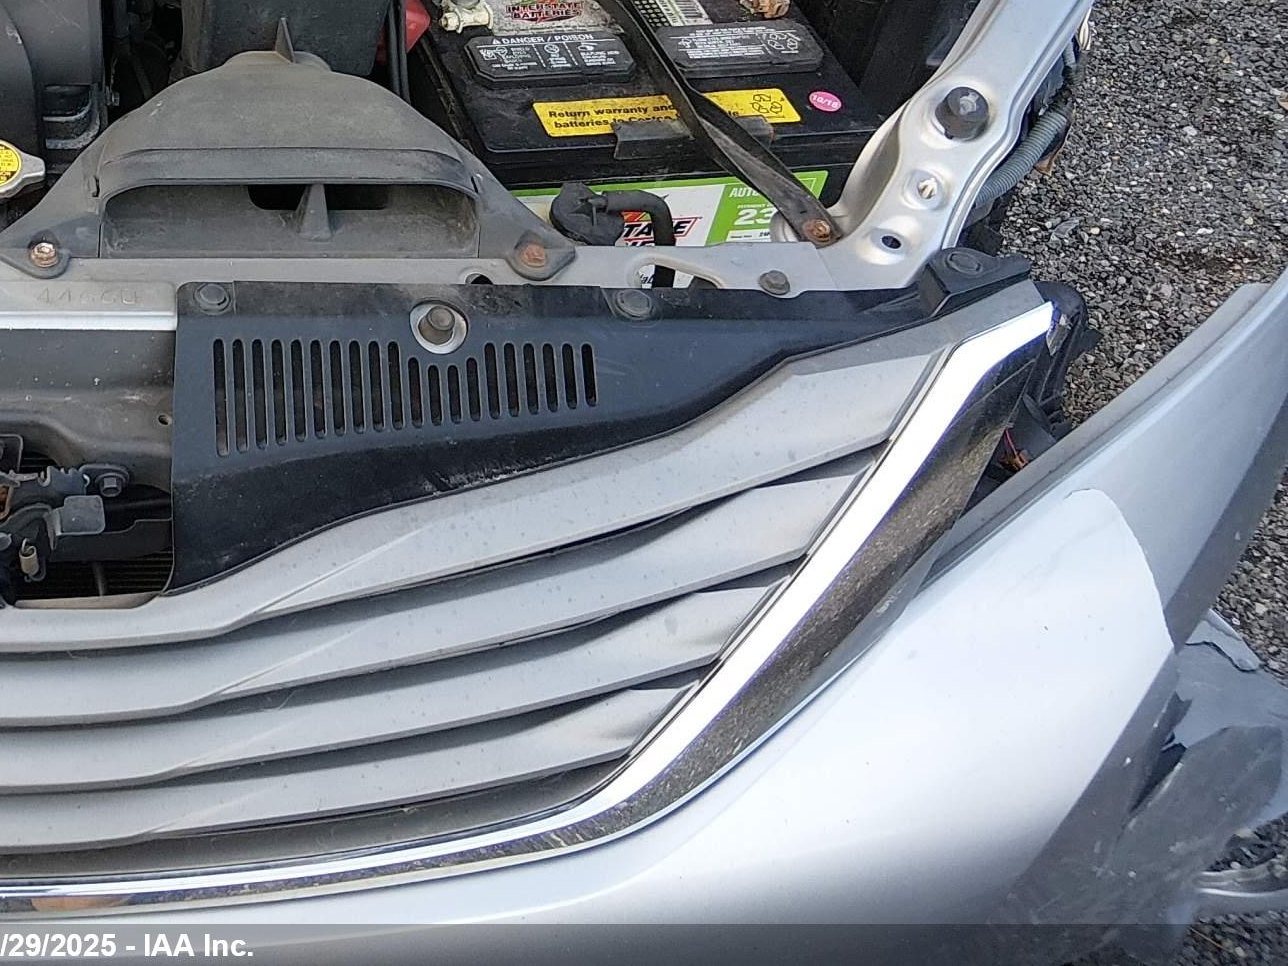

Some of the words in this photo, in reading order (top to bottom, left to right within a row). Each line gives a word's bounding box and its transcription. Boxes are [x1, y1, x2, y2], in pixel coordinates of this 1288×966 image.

[507, 1, 582, 13] INTERSTATE
[513, 9, 582, 19] BATTERIES
[501, 36, 544, 45] DANGER
[554, 34, 594, 42] POISON
[548, 110, 591, 119] Return
[593, 105, 648, 116] warranty
[554, 119, 609, 129] batteries
